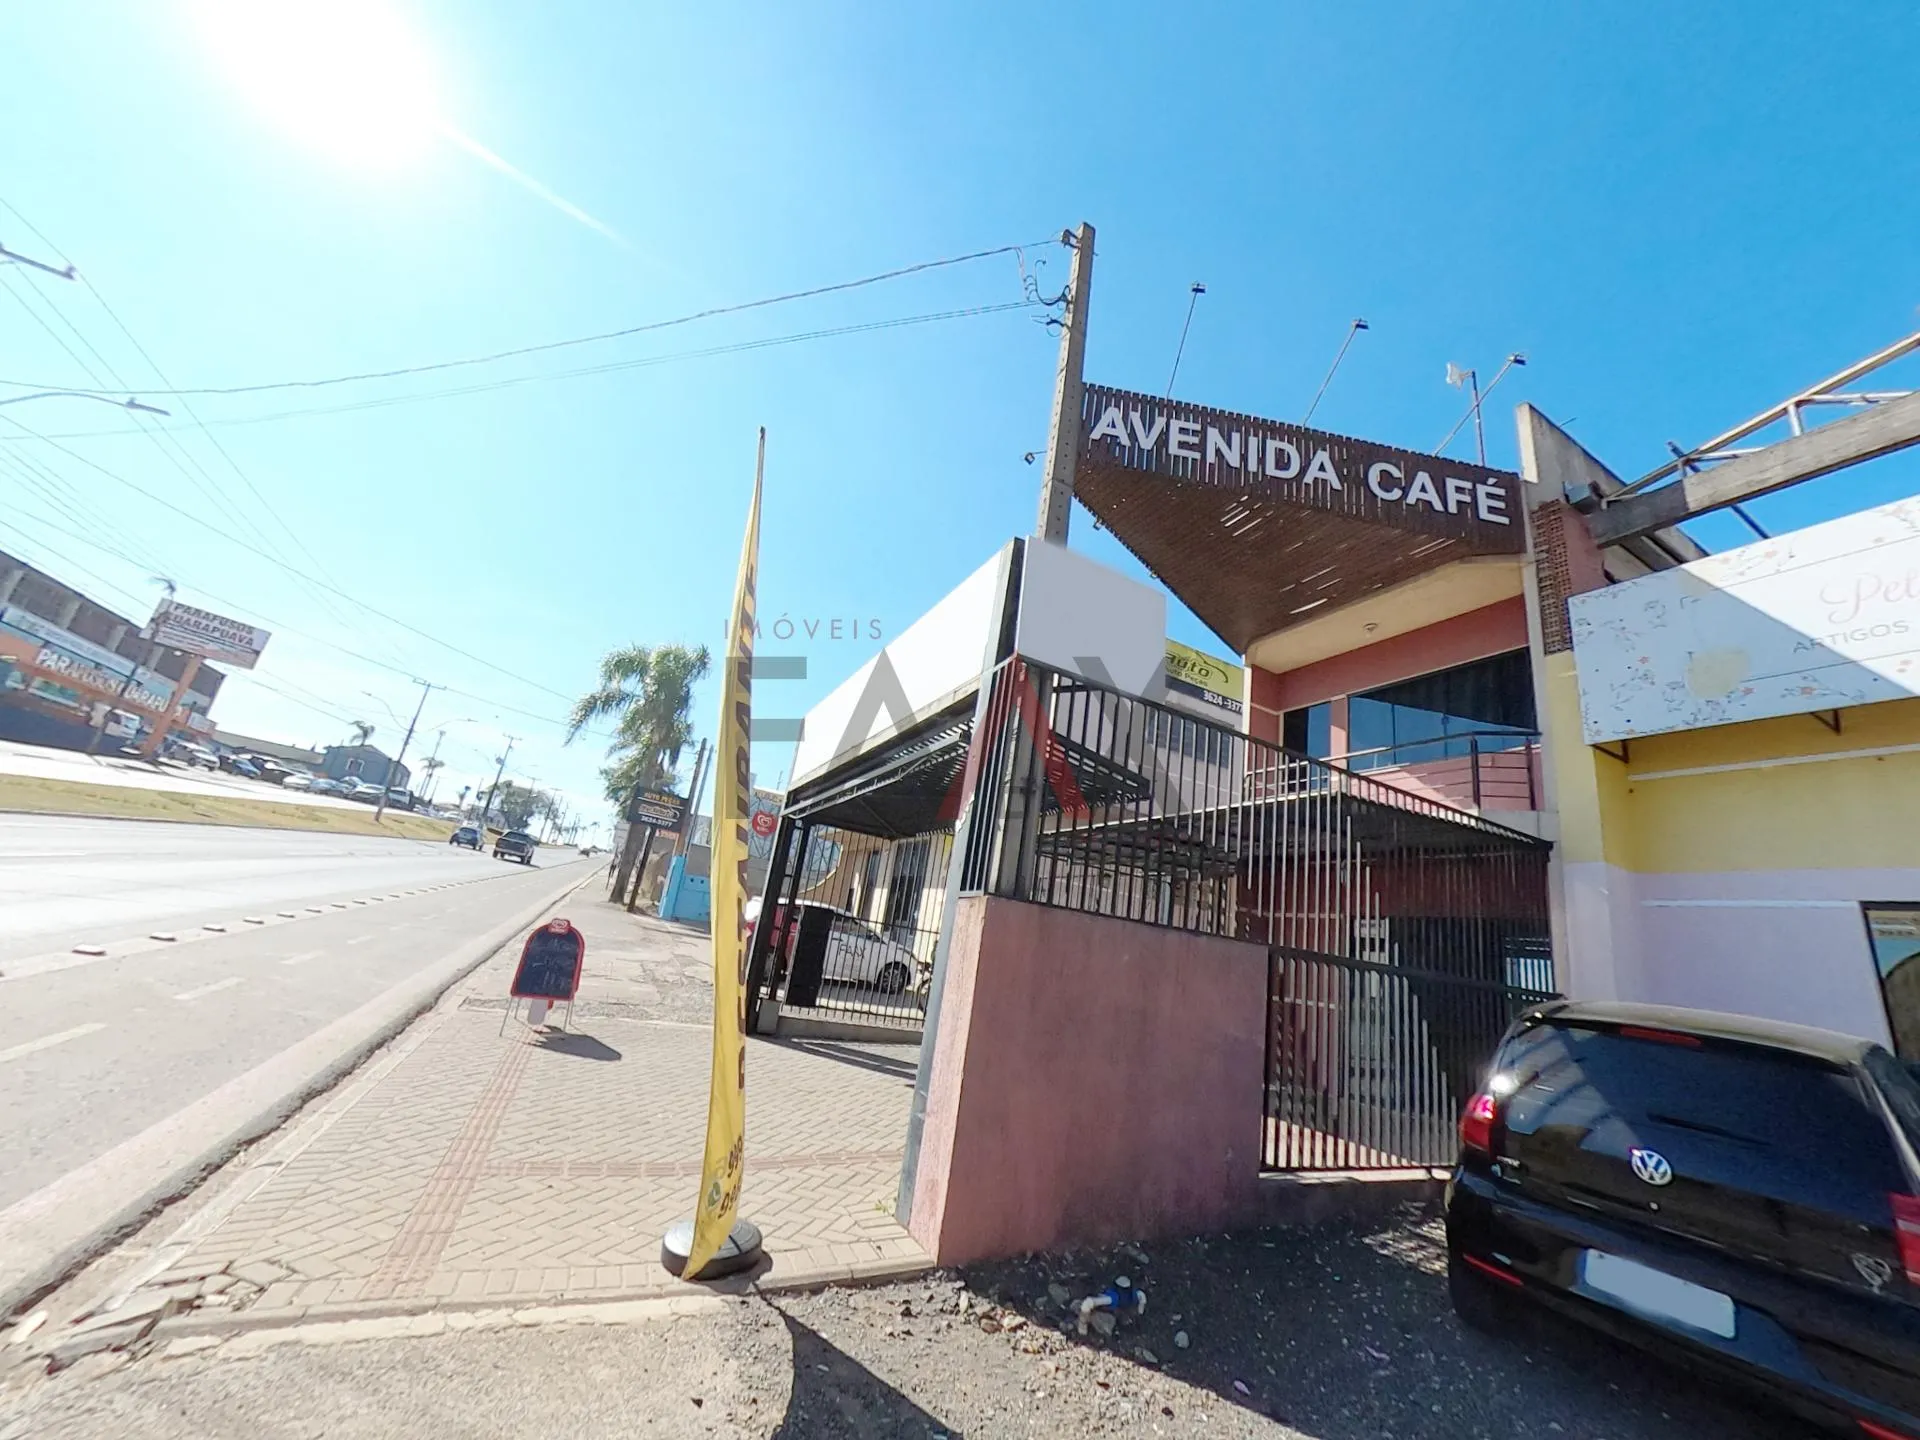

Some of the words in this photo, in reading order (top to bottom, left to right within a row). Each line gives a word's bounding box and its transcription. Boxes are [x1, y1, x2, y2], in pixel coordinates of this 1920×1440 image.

[1089, 406, 1342, 491] AVENIDA
[1367, 462, 1511, 526] CAFÉ
[173, 602, 254, 636] PARAFUSOS
[1793, 620, 1909, 653] ARTIGOS
